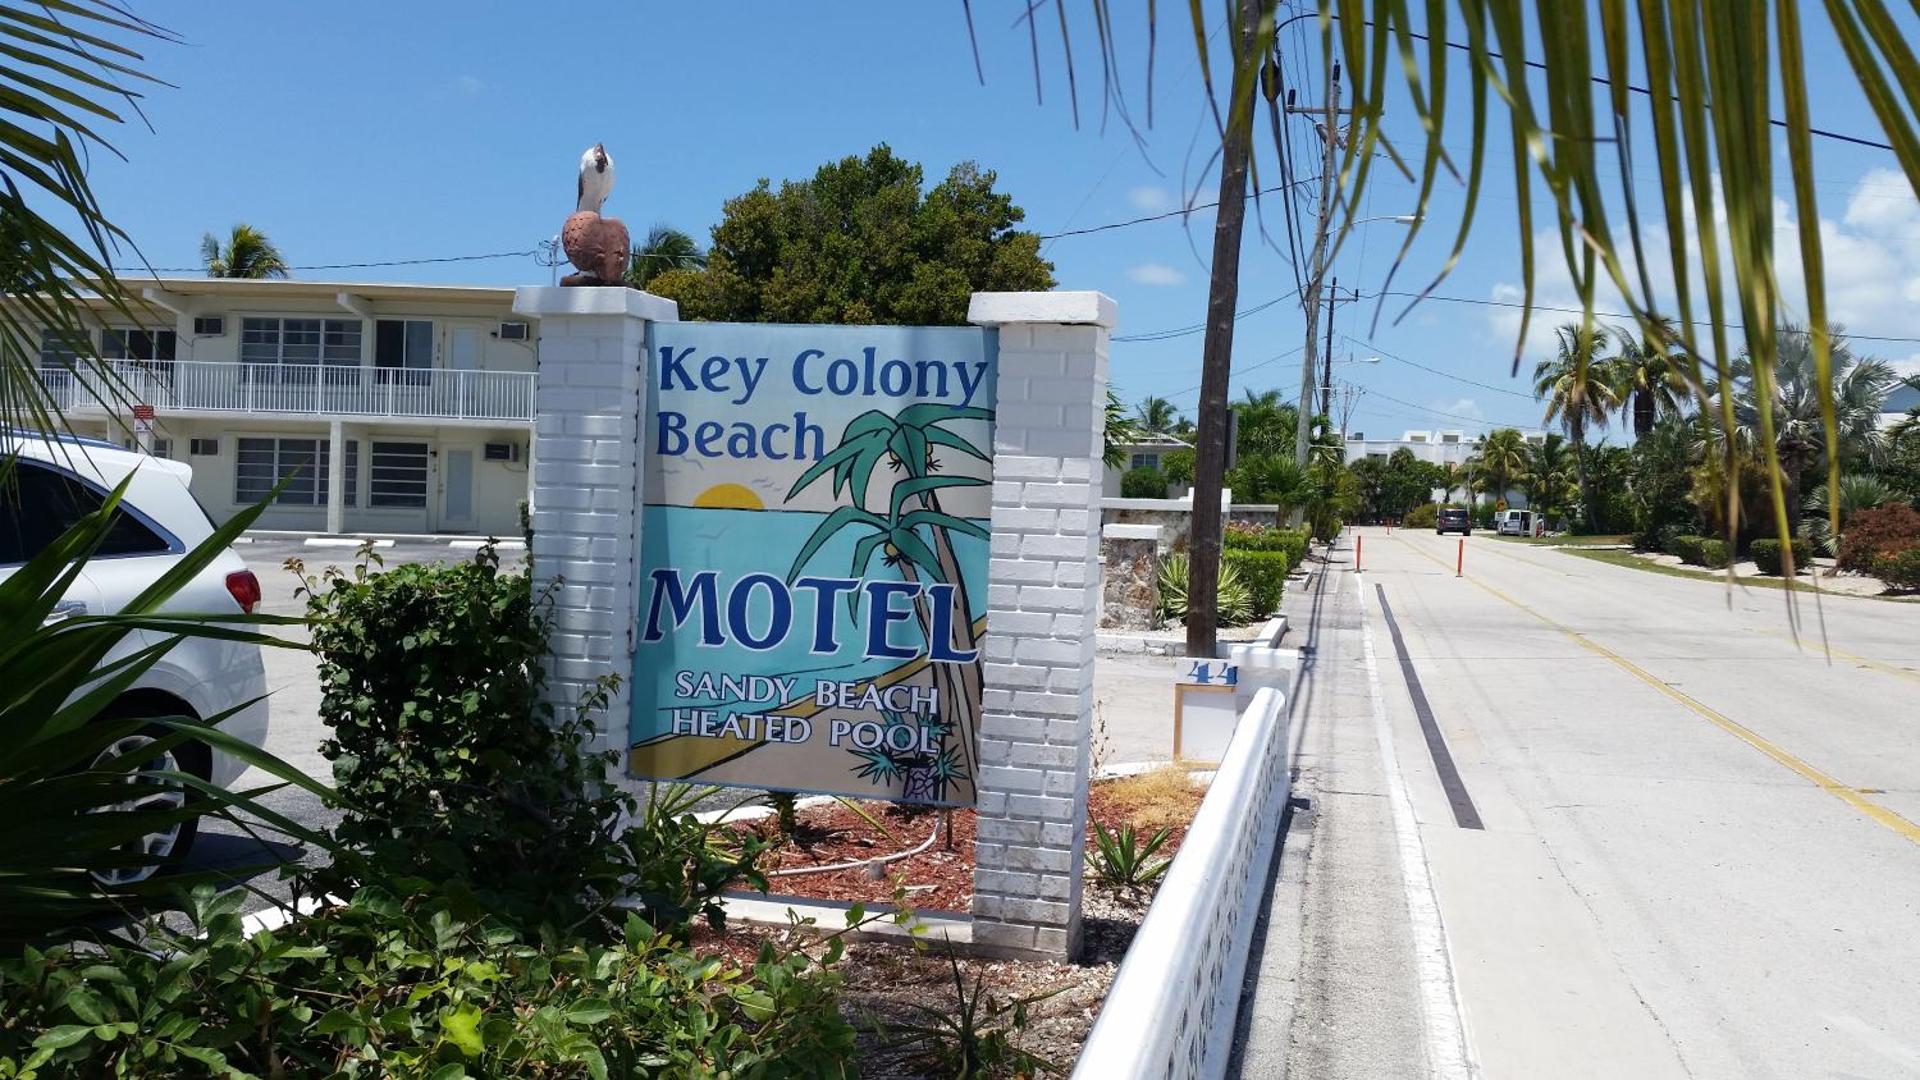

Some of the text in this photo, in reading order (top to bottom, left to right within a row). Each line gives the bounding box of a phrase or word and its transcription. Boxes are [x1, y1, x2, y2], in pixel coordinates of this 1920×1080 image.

[659, 346, 988, 410] Key Colony
[657, 411, 825, 462] Beach
[642, 568, 981, 664] MOTEL
[675, 670, 939, 715] SANDY BEACH
[1187, 660, 1238, 684] 44
[671, 709, 939, 754] HEATED POOL
